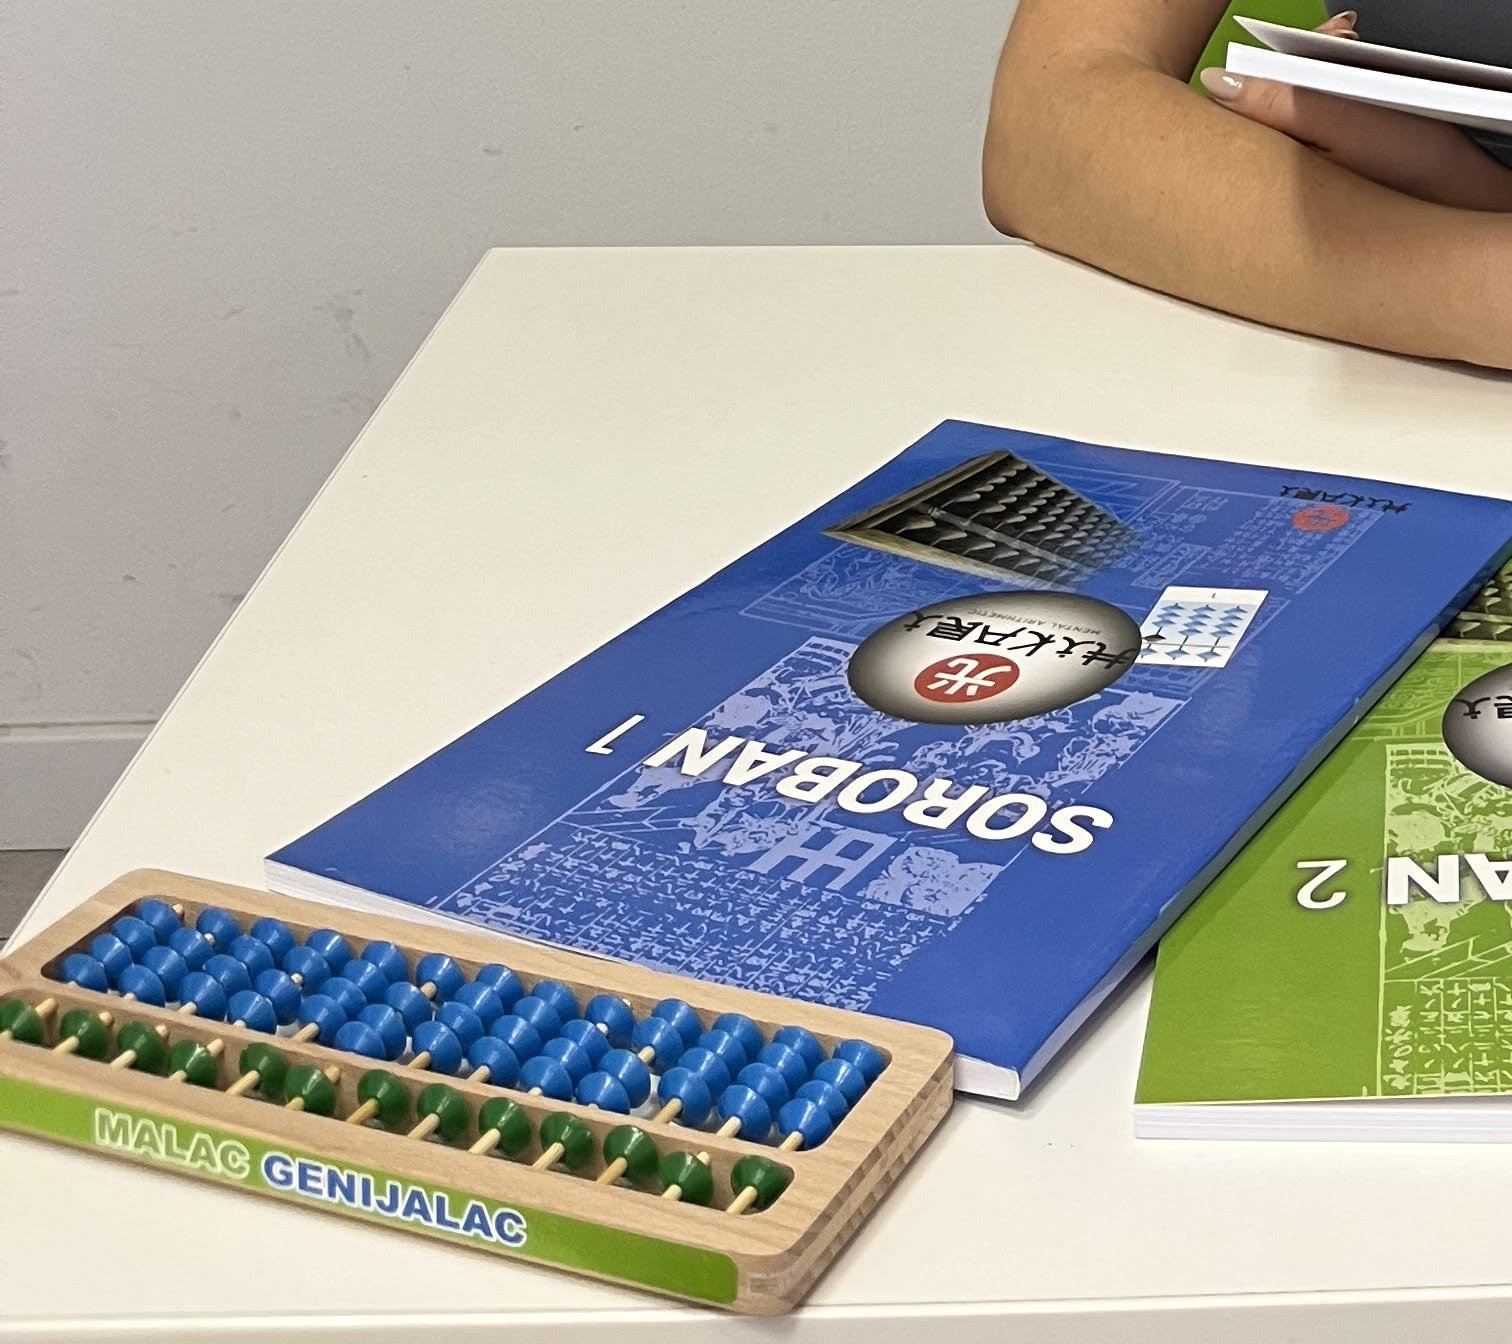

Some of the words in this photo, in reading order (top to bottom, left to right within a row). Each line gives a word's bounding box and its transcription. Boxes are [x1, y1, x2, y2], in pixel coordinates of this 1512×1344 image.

[584, 714, 646, 755] 1
[642, 727, 1114, 854] SOROBAN
[1295, 859, 1348, 910] 2
[94, 1105, 251, 1180] MALAC
[262, 1153, 529, 1248] GENIJALAC
